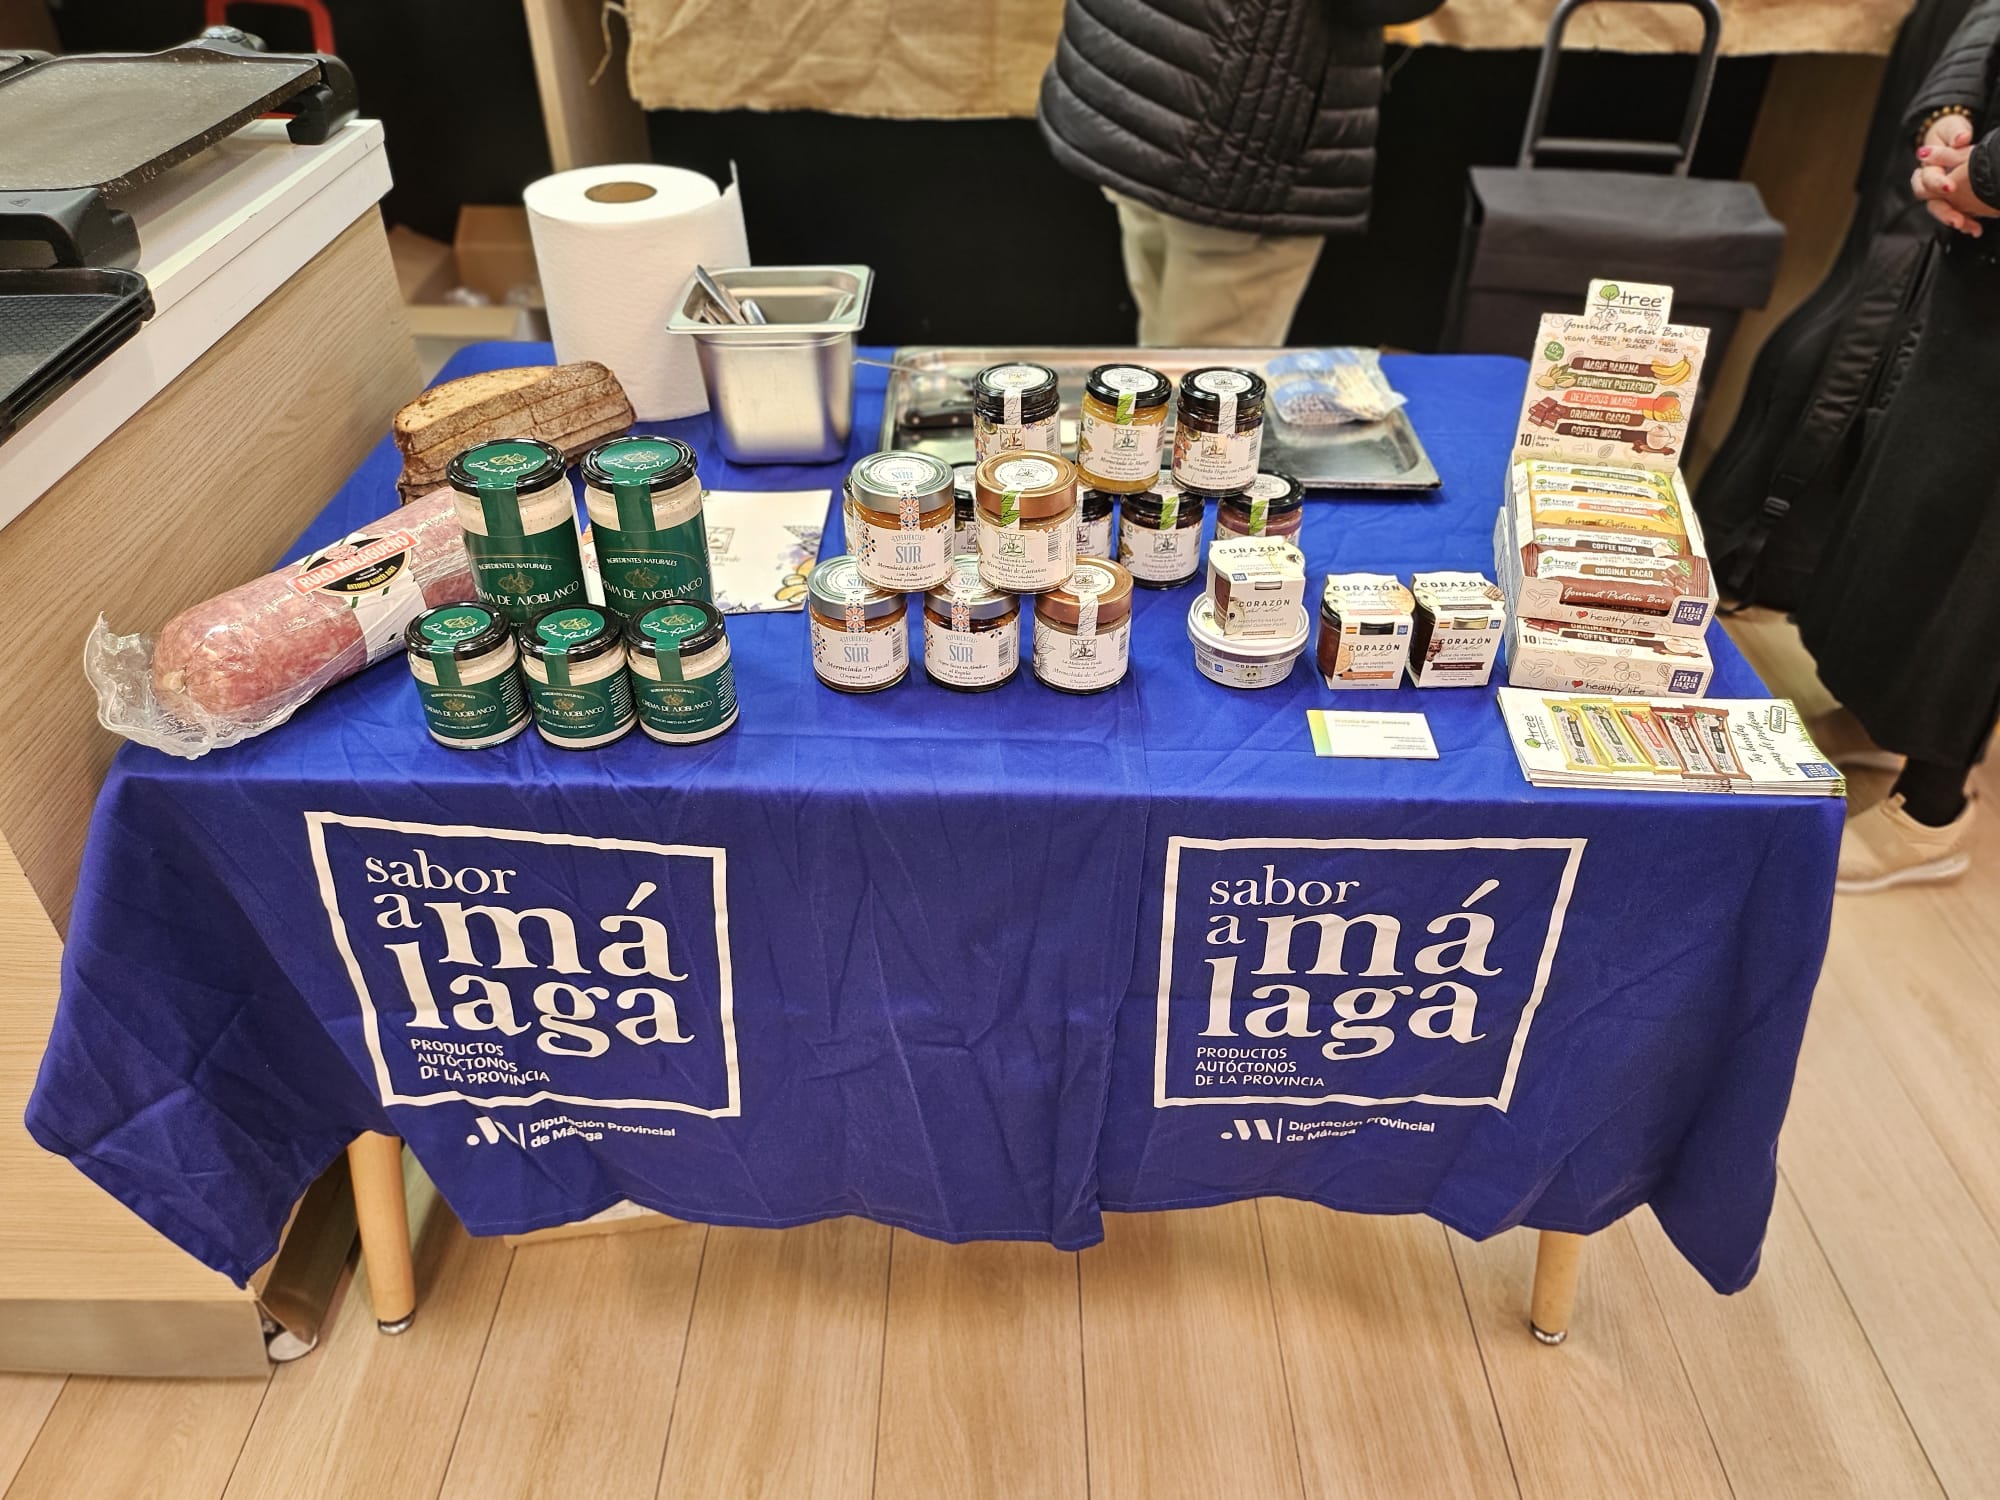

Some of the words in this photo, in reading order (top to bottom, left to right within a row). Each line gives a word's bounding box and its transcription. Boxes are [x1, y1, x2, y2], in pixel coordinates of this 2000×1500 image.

[1620, 290, 1661, 307] tree
[1563, 318, 1612, 333] Gourmet
[1662, 326, 1684, 338] Bar
[1583, 359, 1606, 372] MAGIC
[1609, 362, 1639, 374] BANANA
[1576, 375, 1612, 388] CRUNCHY
[1614, 379, 1654, 393] PISTACHIO
[1570, 394, 1609, 405] DELICIOUS
[1611, 396, 1638, 408] MANGO
[1570, 409, 1604, 422] ORIGINAL
[1606, 412, 1631, 424] CACAO
[1520, 433, 1532, 447] 10
[1571, 425, 1598, 436] COFFEE
[1600, 428, 1622, 439] MOKA
[896, 546, 921, 564] SUR
[1618, 546, 1637, 554] MOKA
[516, 563, 552, 571] NATURALES
[644, 558, 678, 566] NATURALES
[296, 568, 336, 589] RULO
[1595, 568, 1628, 576] ORIGINAL
[1630, 569, 1654, 578] CACAO
[498, 594, 512, 606] DE
[517, 580, 579, 606] AJOBLANCO
[624, 588, 638, 600] DE
[642, 577, 703, 600] AJOBLANCO
[1564, 588, 1605, 600] Gourmet
[1607, 591, 1642, 602] Protein
[1648, 594, 1666, 604] Bar
[1238, 598, 1290, 608] CORAZÓN
[1683, 604, 1704, 614] má
[1590, 612, 1627, 626] healthy
[1631, 616, 1650, 627] life
[1677, 610, 1701, 621] laga
[1523, 634, 1537, 644] 10
[1577, 632, 1610, 641] COFFEE
[1612, 636, 1636, 645] MOKA
[844, 646, 870, 663] SUR
[949, 644, 973, 662] SUR
[1348, 644, 1400, 652] CORAZÓN
[826, 662, 862, 672] Mermelada
[864, 660, 890, 673] Tropical
[1673, 679, 1696, 690] laga
[1679, 673, 1698, 683] má
[1585, 682, 1624, 696] healthy
[1627, 685, 1646, 696] life
[454, 704, 497, 718] AJOBLANCO
[563, 706, 605, 717] AJOBLANCO
[672, 700, 713, 712] AJOBLANCO
[1524, 715, 1540, 738] tree
[366, 848, 516, 895] sabor
[1209, 864, 1360, 907] sabor
[373, 893, 422, 929] a
[424, 881, 689, 982] má
[1206, 914, 1247, 945] a
[1250, 878, 1503, 977] má
[384, 941, 696, 1058] laga
[1198, 956, 1487, 1061] laga
[410, 1038, 504, 1057] PRODUCTOS
[1196, 1046, 1288, 1060] PRODUCTOS
[418, 1053, 519, 1073] AUTÓCTONOS
[1195, 1058, 1298, 1074] AUTÓCTONOS
[420, 1065, 440, 1080] DE
[444, 1068, 464, 1083] LA
[468, 1069, 550, 1086] PROVINCIA
[1195, 1074, 1214, 1086] DE
[1218, 1074, 1238, 1086] LA
[1242, 1074, 1325, 1087] PROVINCIA
[530, 1115, 605, 1134] Diputación
[607, 1122, 676, 1138] Provincial
[1288, 1119, 1364, 1132] Diputación
[1366, 1116, 1436, 1133] Provincial
[530, 1132, 550, 1148] de
[552, 1126, 603, 1142] Málaga
[1286, 1133, 1304, 1143] de
[1307, 1127, 1357, 1140] Málaga
